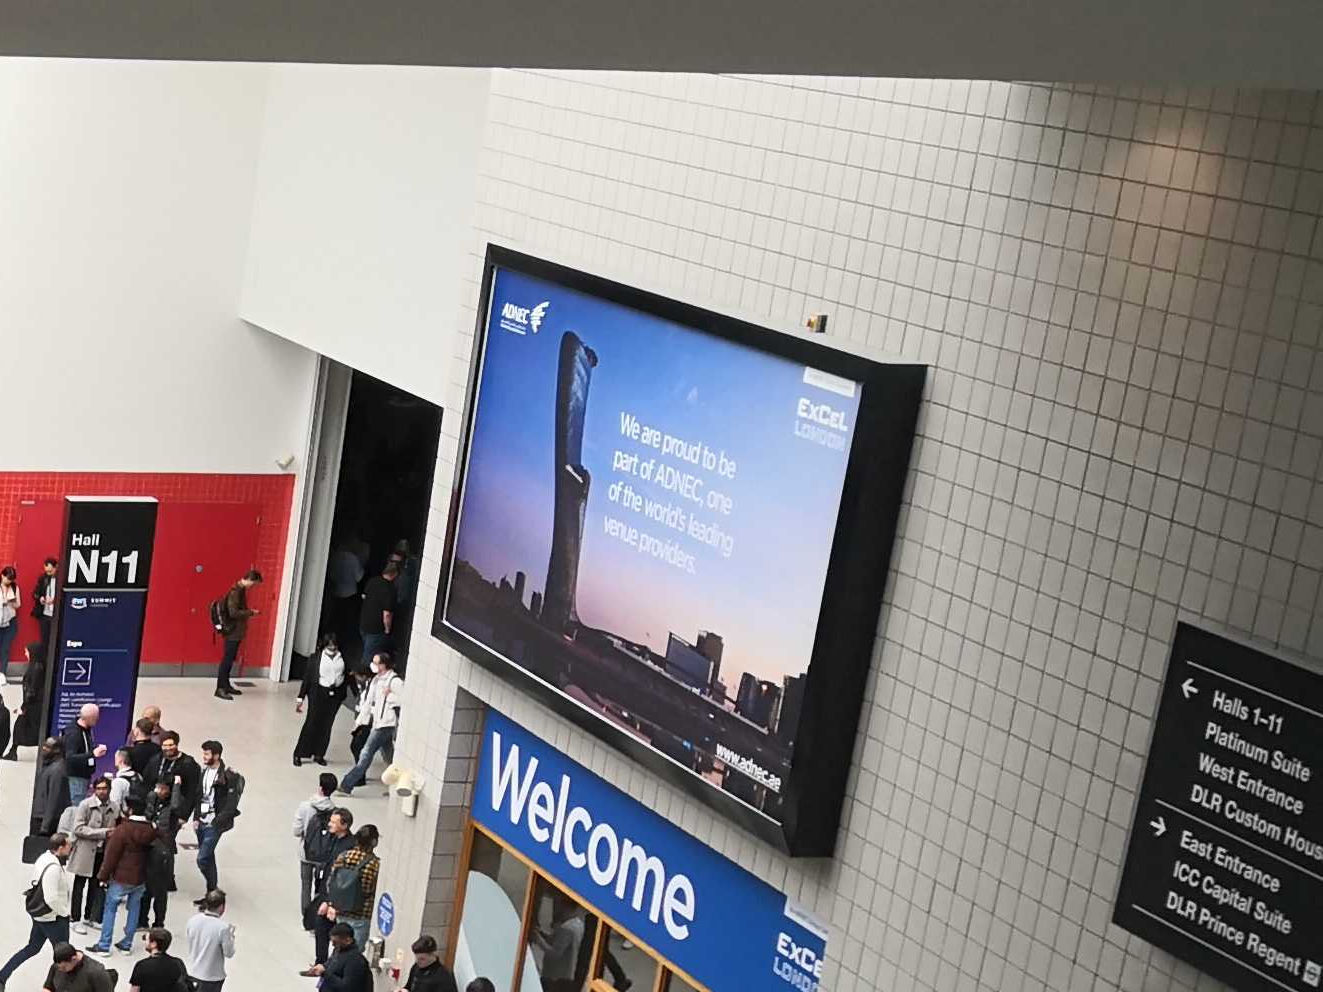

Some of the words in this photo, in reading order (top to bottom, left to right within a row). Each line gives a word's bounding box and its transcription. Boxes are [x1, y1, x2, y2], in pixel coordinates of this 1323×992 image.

[501, 302, 531, 325] ADNEC
[619, 411, 641, 440] We
[641, 425, 661, 448] are
[661, 434, 702, 465] proud
[703, 445, 716, 471] to
[718, 450, 737, 479] be
[613, 450, 639, 476] part
[640, 459, 656, 481] of
[655, 463, 704, 508] ADNEC,
[706, 489, 733, 515] one
[72, 533, 100, 546] Hall
[604, 515, 639, 548] venue
[638, 532, 697, 574] providers.
[608, 481, 624, 502] of
[623, 485, 643, 513] the
[687, 512, 734, 558] leading
[67, 549, 139, 584] N11
[66, 640, 83, 648] Expo
[1212, 689, 1249, 721] Halls
[716, 743, 782, 791] www.adnec.ae
[1205, 721, 1269, 764] Platinum
[1271, 750, 1311, 782] Suite
[1199, 752, 1236, 785] West
[1237, 769, 1304, 815] Entrance
[491, 731, 695, 941] Welcome
[1190, 784, 1223, 814] DLR
[1225, 800, 1282, 841] Custom
[1283, 826, 1323, 860] Hous
[1179, 830, 1212, 860] East
[1214, 846, 1281, 893] Entrance
[1173, 860, 1201, 888] ICC
[1202, 876, 1253, 914] Capital
[1254, 901, 1292, 935] Suite
[776, 932, 823, 979] ExCe
[1166, 890, 1197, 921] DLR
[1198, 908, 1245, 946] Prince
[1246, 932, 1302, 976] Regent
